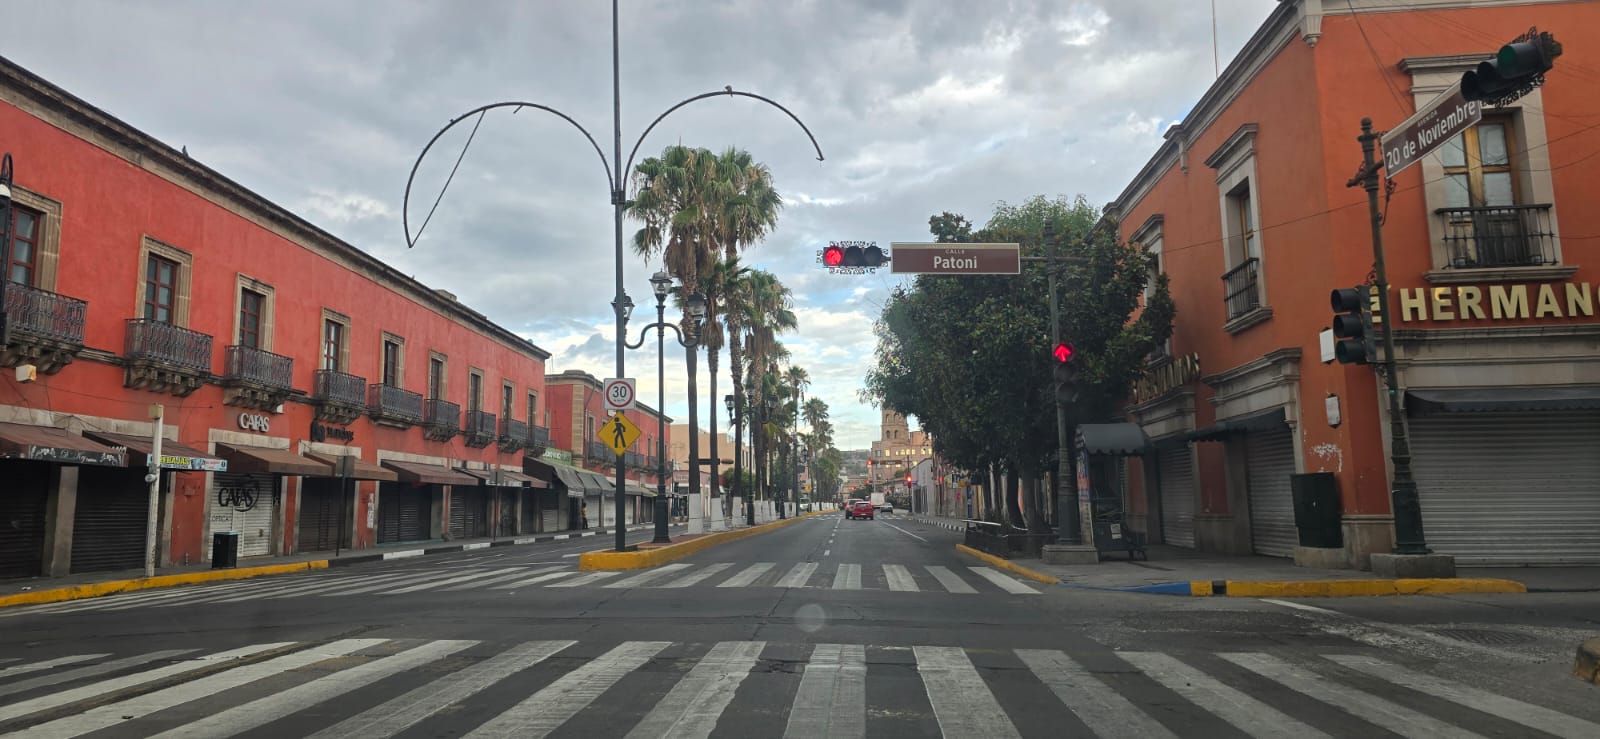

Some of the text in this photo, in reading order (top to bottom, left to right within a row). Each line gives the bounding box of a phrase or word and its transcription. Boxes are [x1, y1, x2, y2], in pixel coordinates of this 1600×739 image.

[1386, 100, 1476, 170] 20 de Noviembre
[933, 255, 977, 269] Patoni
[1399, 282, 1600, 322] HERMAN
[612, 386, 627, 398] 30
